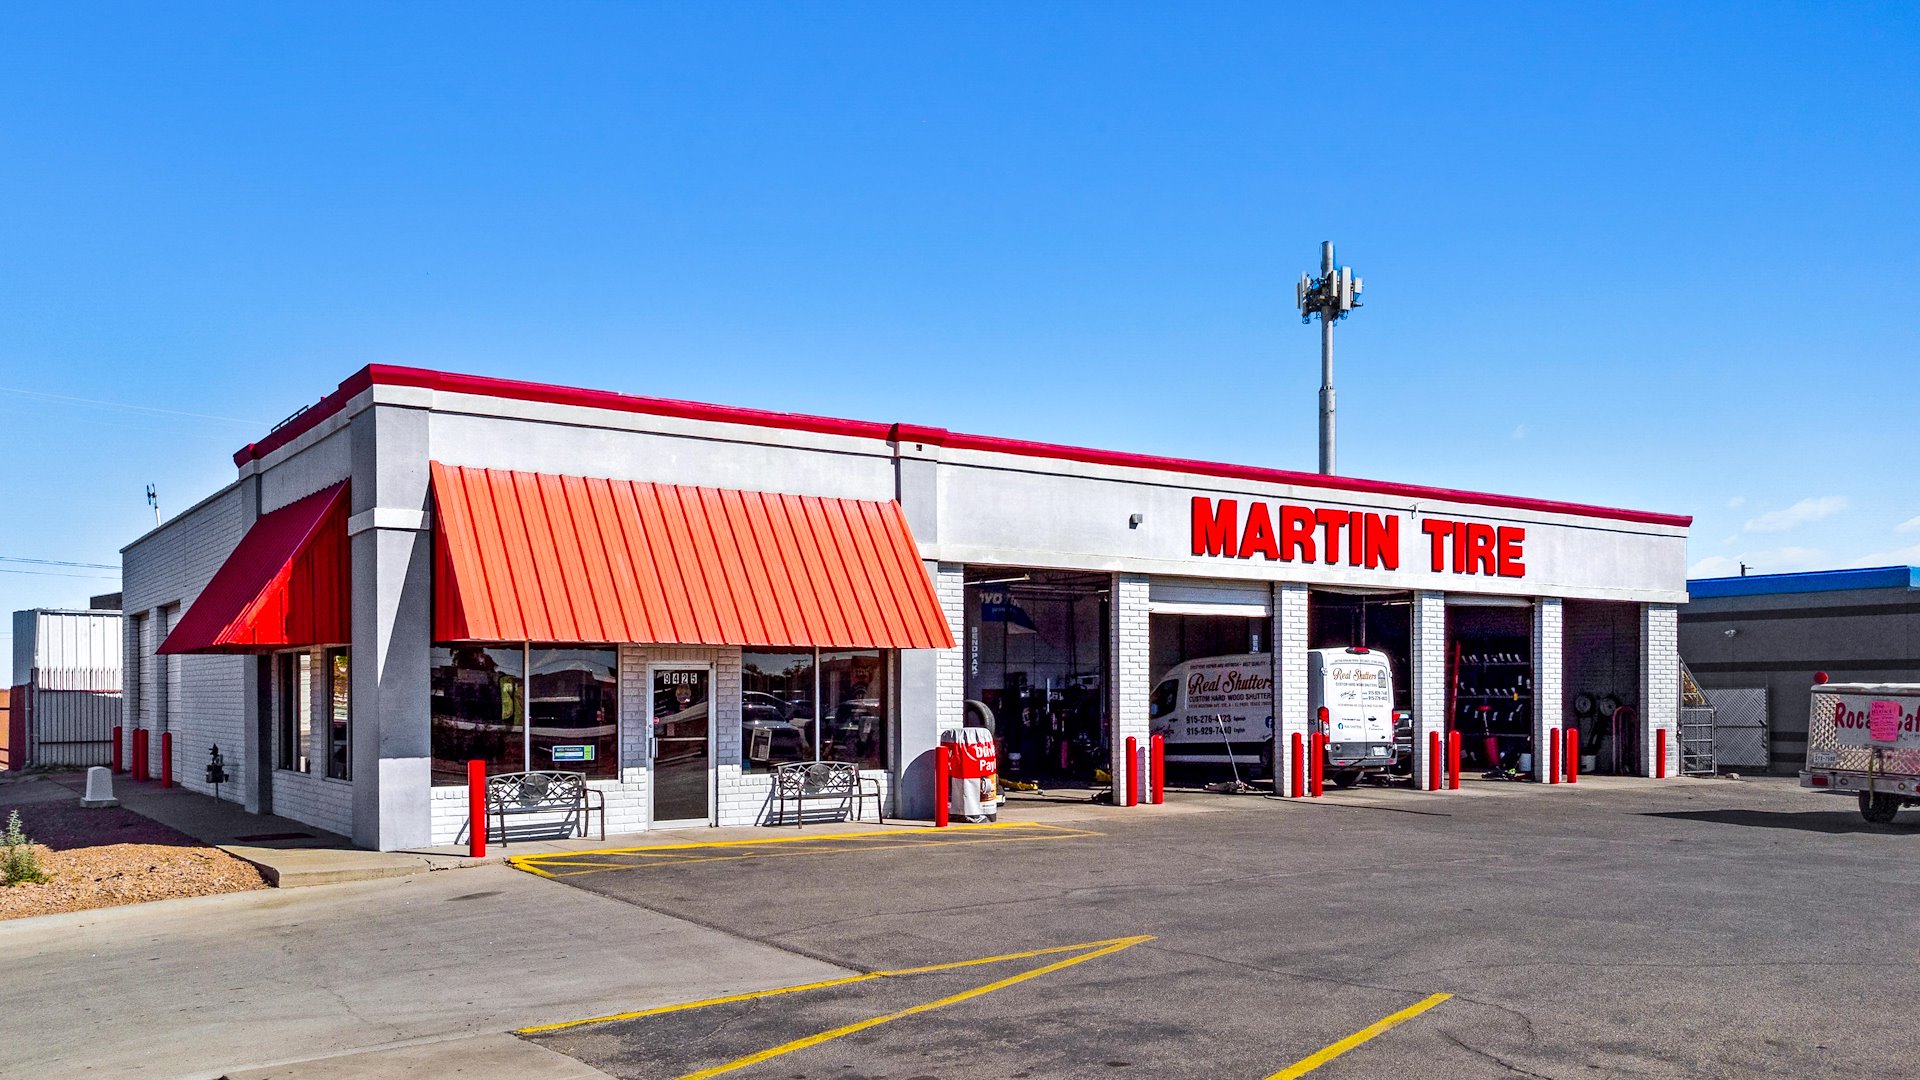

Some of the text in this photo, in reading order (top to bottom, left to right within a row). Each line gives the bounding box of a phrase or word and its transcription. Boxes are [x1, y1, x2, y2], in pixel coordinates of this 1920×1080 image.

[1191, 496, 1526, 578] MARTIN TIRE
[664, 673, 697, 685] 9425
[1333, 668, 1377, 682] Real Shutters
[1188, 672, 1221, 695] Real
[1189, 695, 1210, 703] CUSTOM
